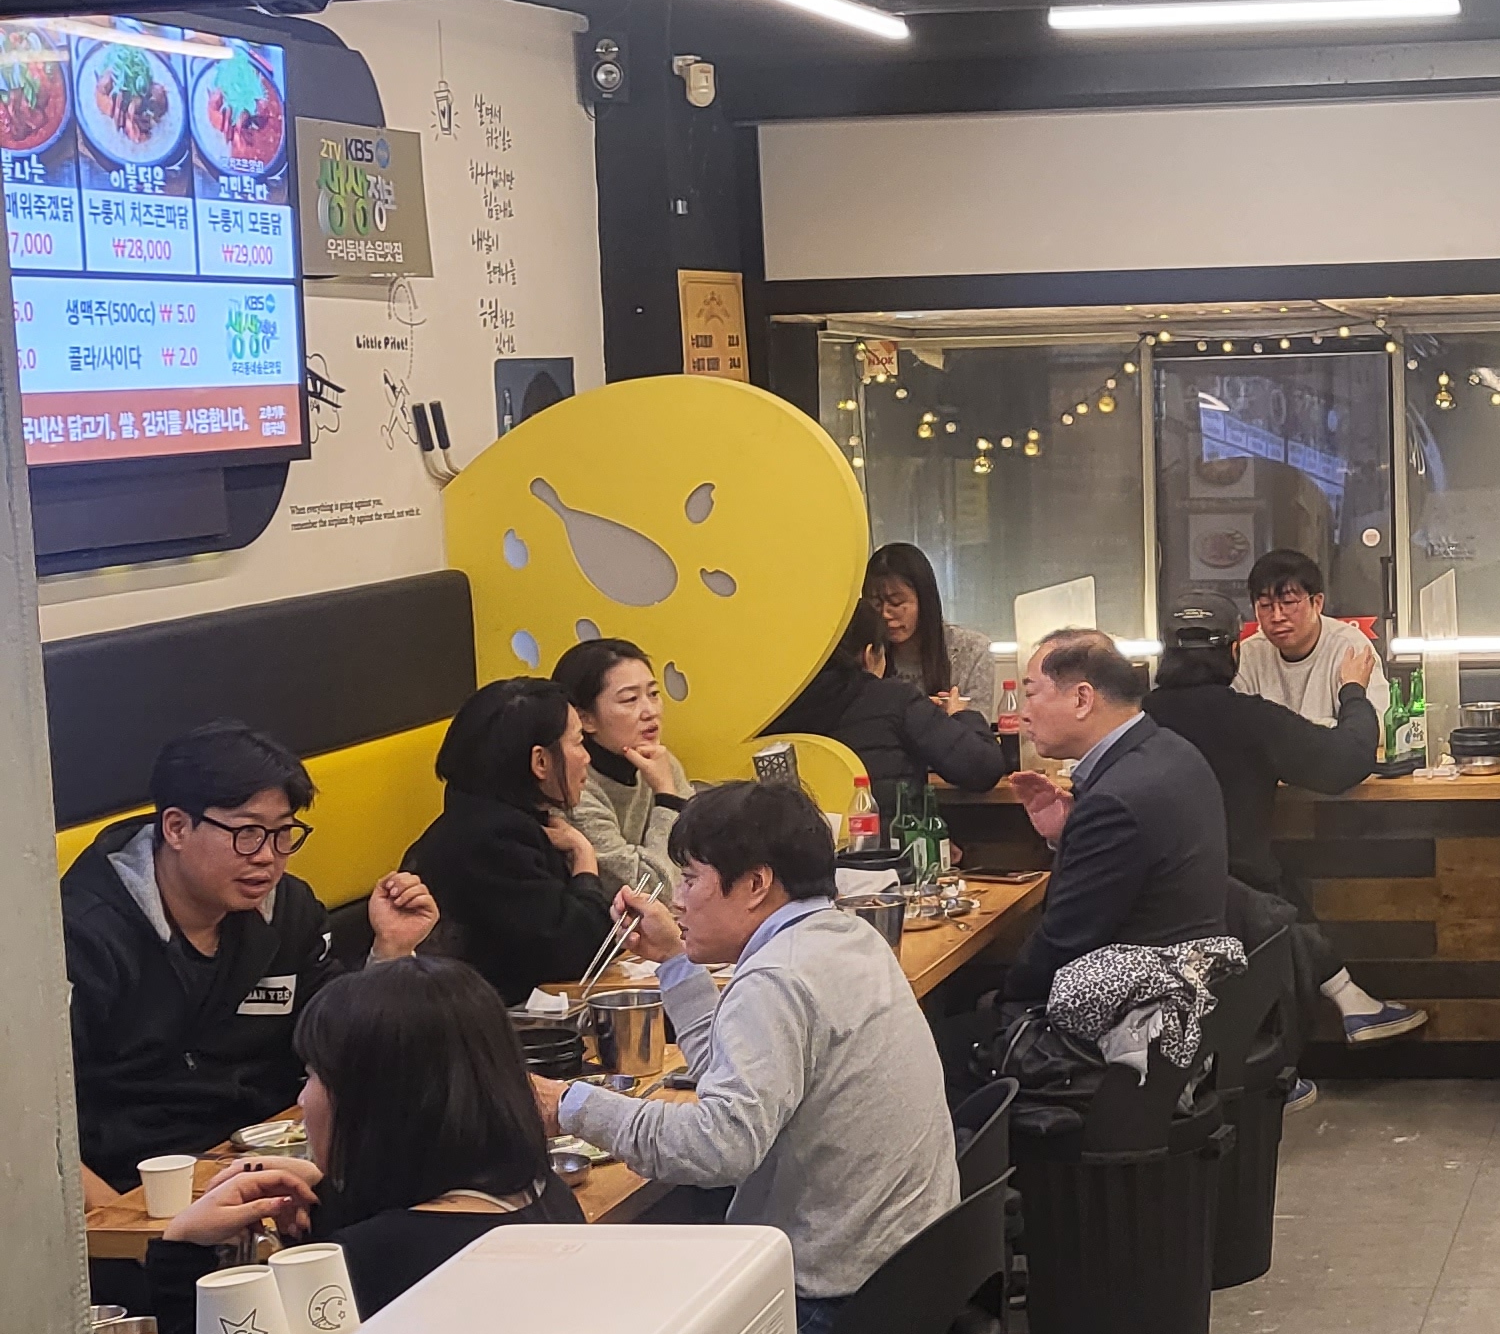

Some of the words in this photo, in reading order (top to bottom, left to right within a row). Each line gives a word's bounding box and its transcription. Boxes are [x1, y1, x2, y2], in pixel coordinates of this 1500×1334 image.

[474, 93, 501, 127] 살면서
[320, 138, 341, 161] 2TV
[345, 137, 374, 163] KBS
[109, 164, 167, 192] 이불덮은
[88, 197, 126, 226] 누룽지
[130, 201, 189, 230] 치즈콘파닭
[208, 206, 244, 233] 누룽지
[248, 211, 283, 236] 모듬닭
[9, 232, 53, 258] 7,000
[112, 237, 172, 263] ₩28,000
[221, 243, 273, 266] ₩29,000
[66, 299, 156, 326] 생맥주(500cc)
[177, 304, 196, 323] 5.0
[244, 295, 265, 312] KBS
[356, 334, 382, 349] Little
[384, 336, 408, 351] Pilot!
[68, 345, 142, 371] 콜라/사이다
[179, 347, 198, 367] 2.0
[67, 412, 115, 441] 닭고기,
[118, 411, 139, 440] 쌀,
[141, 410, 183, 437] 김치를
[185, 406, 249, 434] 사용합니다.
[267, 989, 290, 1001] YES
